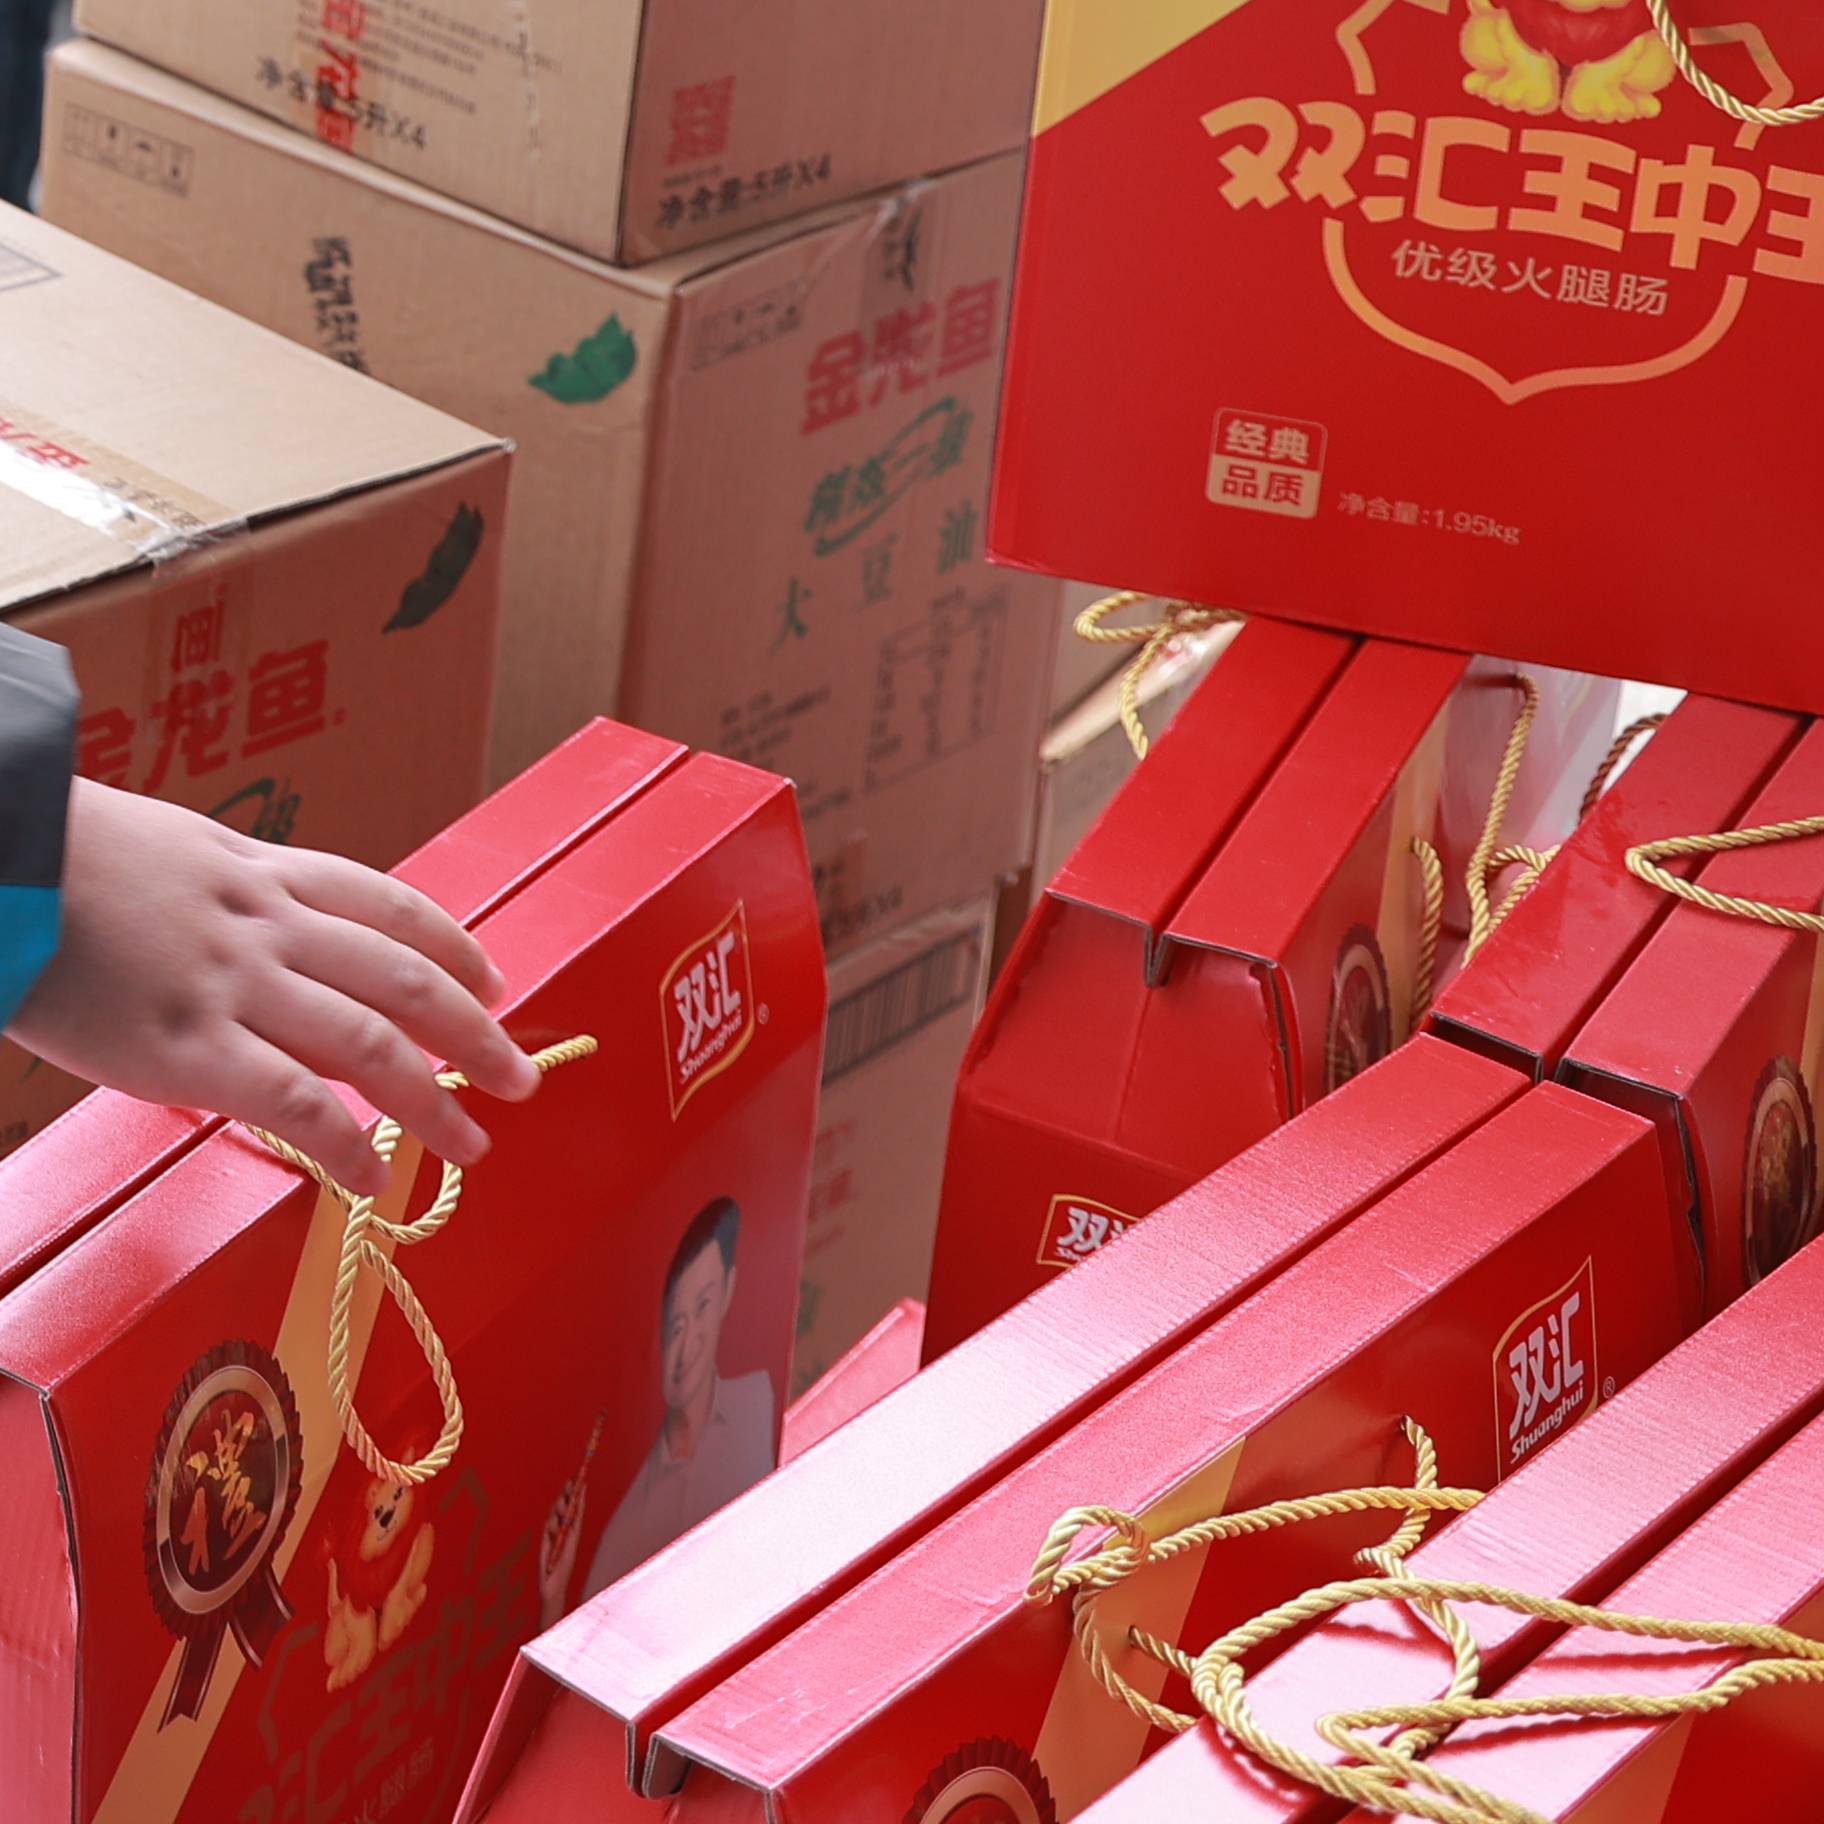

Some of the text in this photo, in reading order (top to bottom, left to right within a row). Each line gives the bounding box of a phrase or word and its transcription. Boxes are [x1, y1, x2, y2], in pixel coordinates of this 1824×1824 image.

[1390, 238, 1670, 317] 优级火腿肠
[1225, 419, 1310, 464] 经典
[1221, 464, 1305, 506] 品质
[674, 930, 741, 1063] 双汇
[1509, 1291, 1585, 1441] 双汇
[1510, 1379, 1585, 1464] Shuanghui
